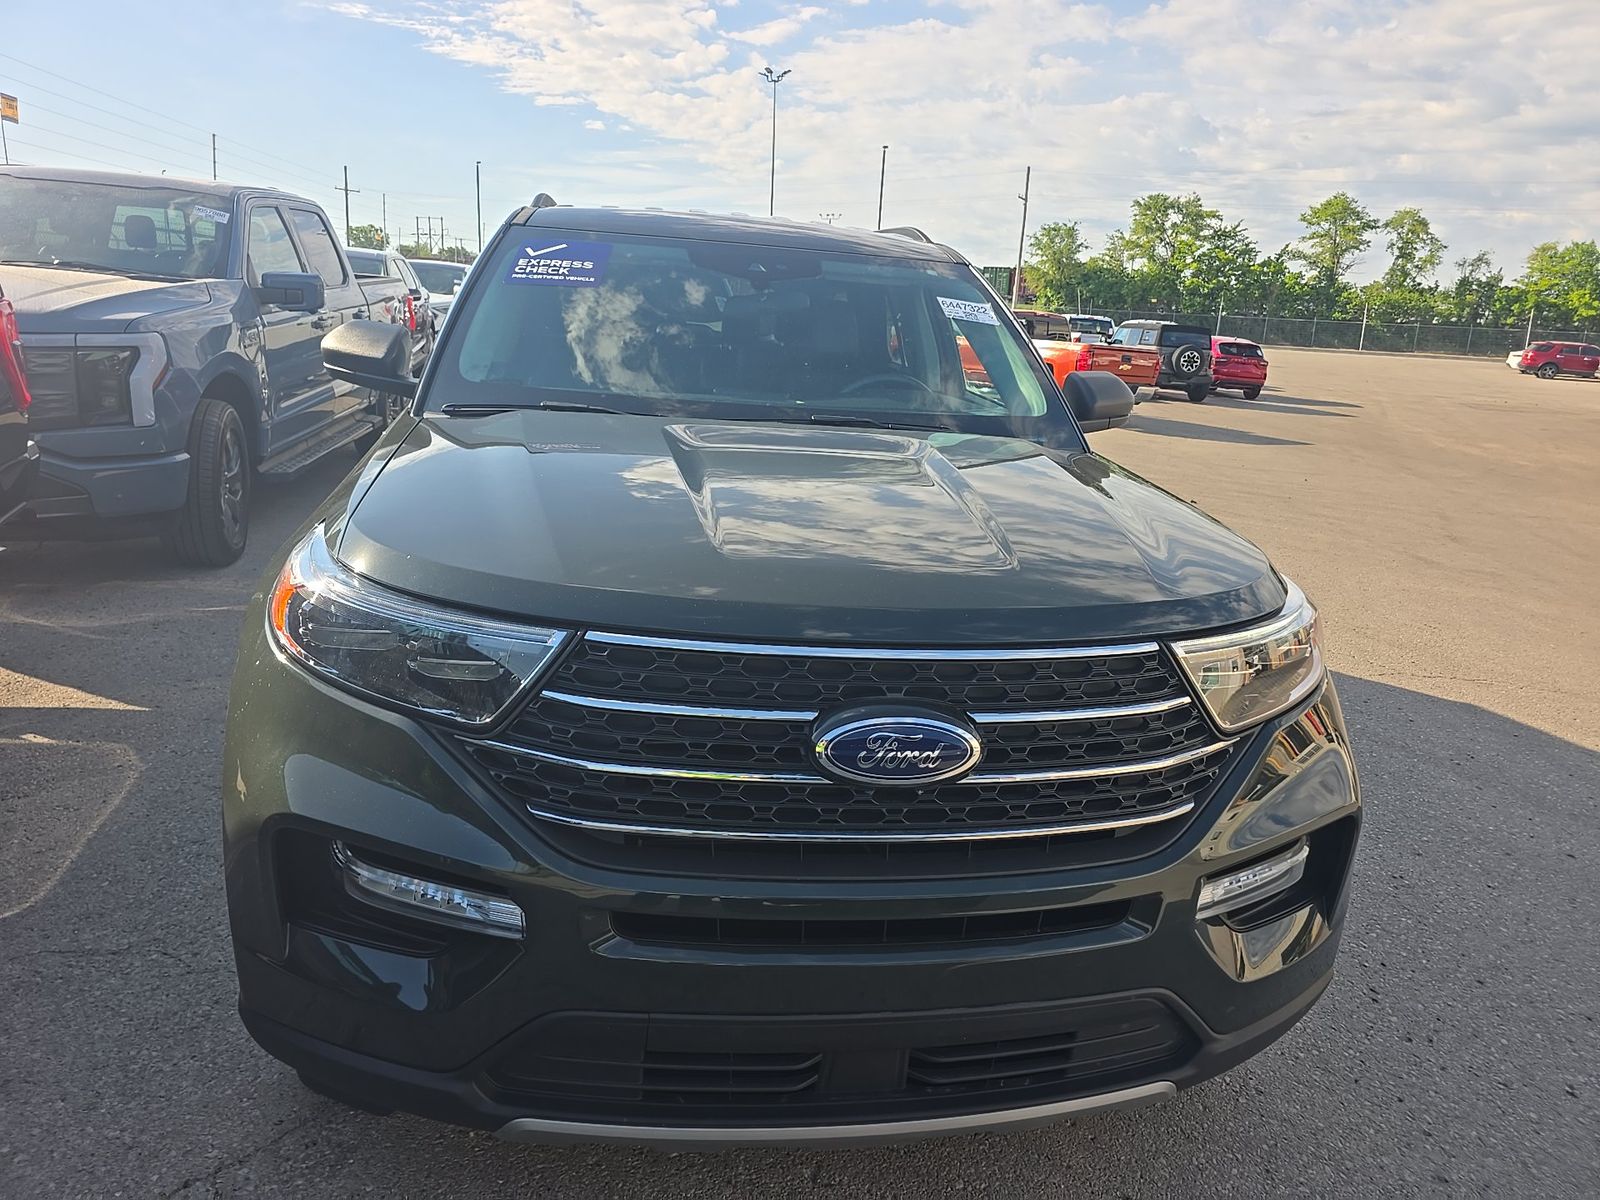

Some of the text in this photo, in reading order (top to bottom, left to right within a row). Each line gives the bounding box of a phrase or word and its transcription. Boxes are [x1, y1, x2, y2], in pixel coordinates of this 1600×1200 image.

[517, 258, 594, 269] EXPRESS
[514, 265, 570, 275] CHECK
[857, 732, 946, 769] Ford
